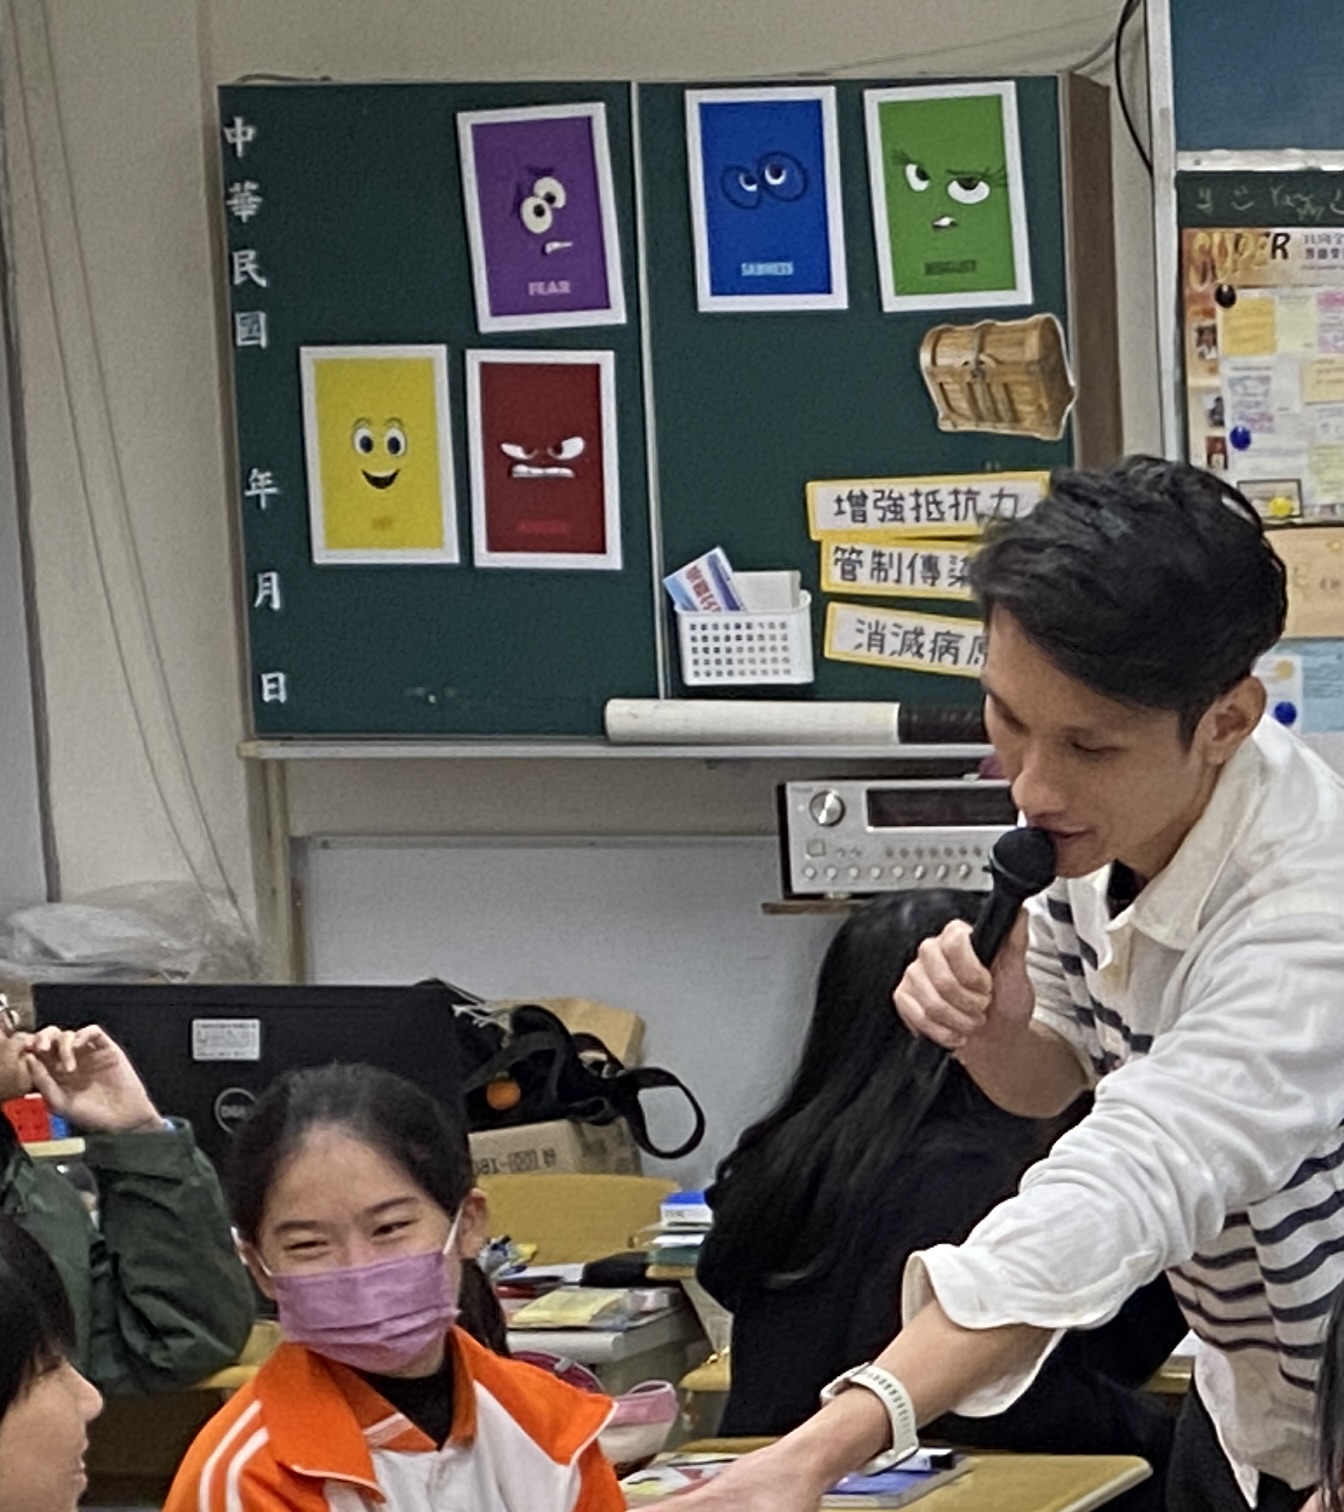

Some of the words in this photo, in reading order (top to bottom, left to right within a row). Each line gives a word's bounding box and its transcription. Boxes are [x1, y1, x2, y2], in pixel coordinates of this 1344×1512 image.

[223, 116, 267, 348] 中華民國
[529, 281, 571, 296] FEAR
[244, 468, 279, 510] 年
[833, 487, 1019, 524] 增強抵抗力
[254, 571, 281, 610] 月
[261, 672, 287, 703] 日
